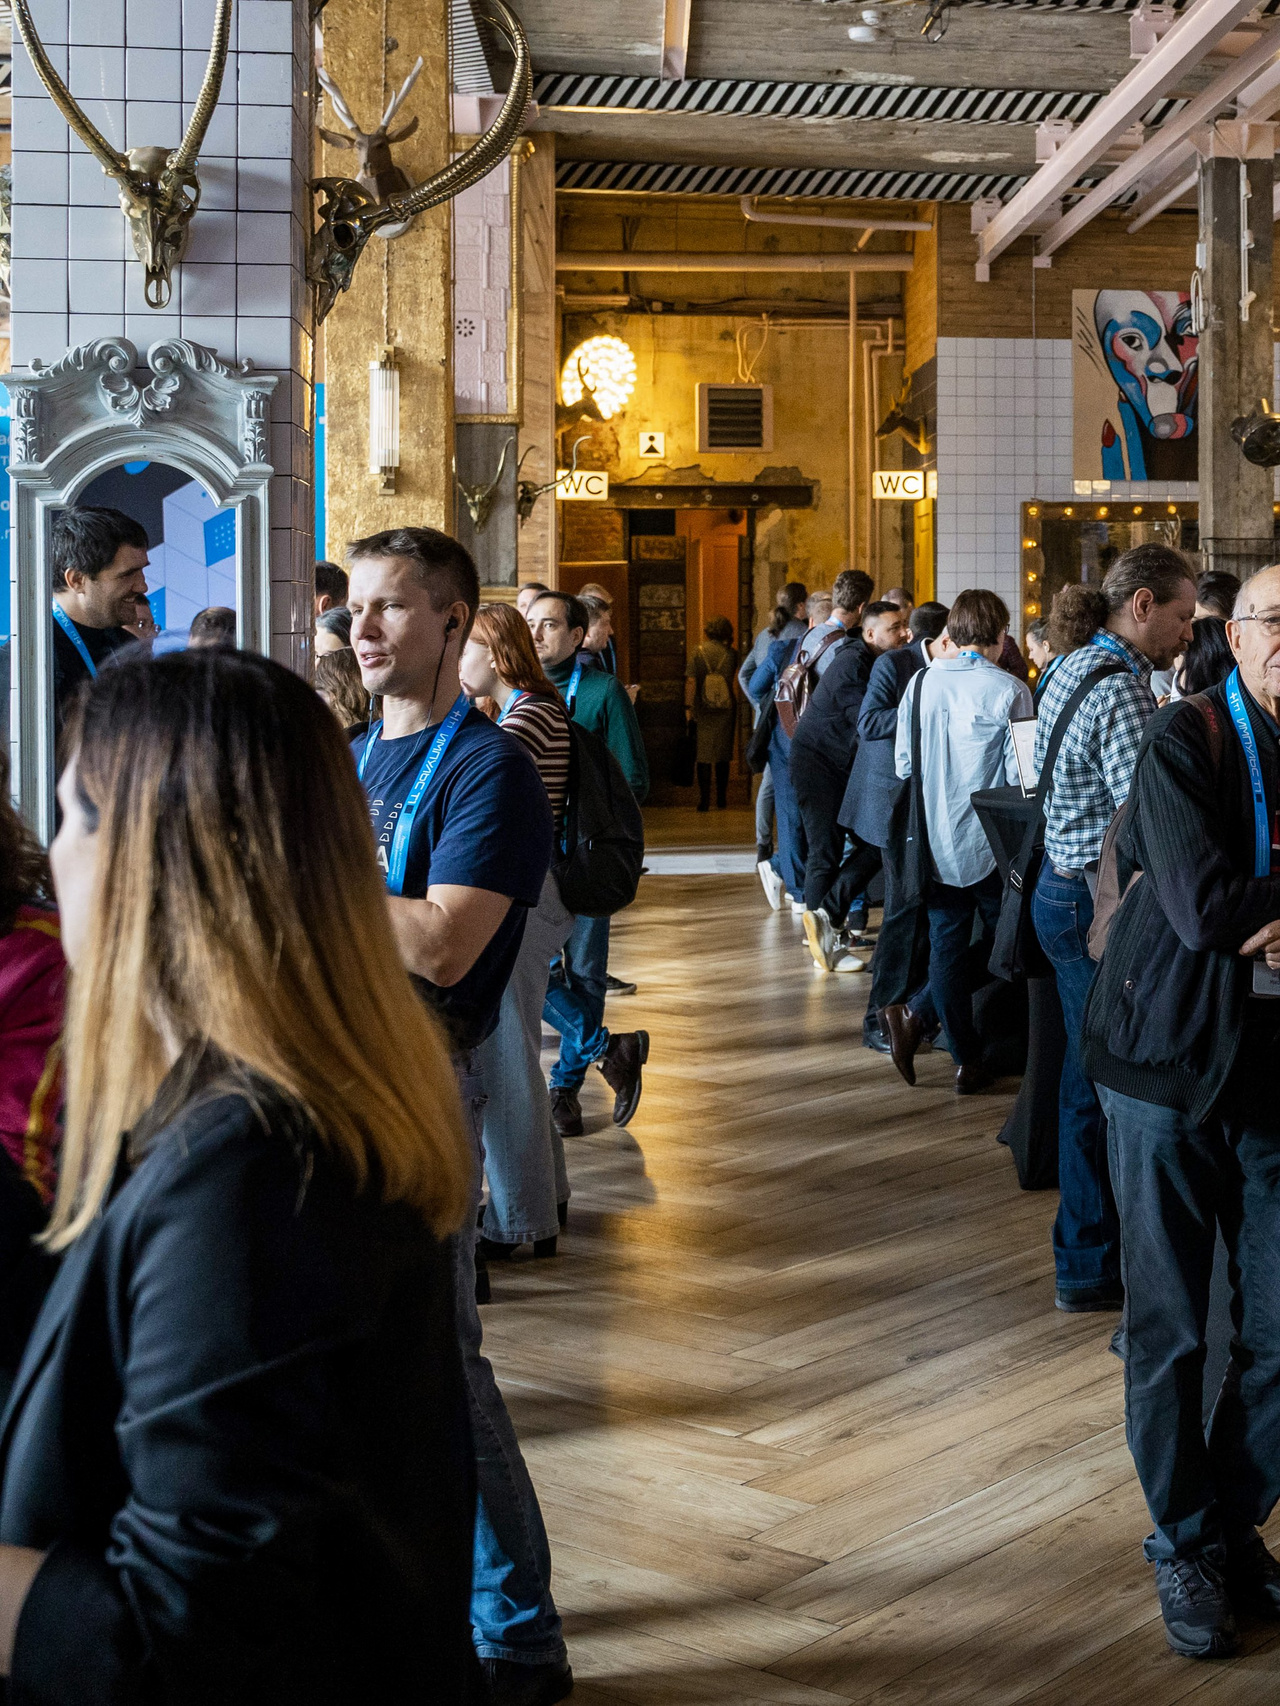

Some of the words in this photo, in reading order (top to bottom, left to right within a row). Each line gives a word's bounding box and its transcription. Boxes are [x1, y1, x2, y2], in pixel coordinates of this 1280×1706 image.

[561, 475, 604, 495] WC
[879, 475, 919, 494] WC
[414, 732, 449, 790] ИМПУЛЬС
[1237, 717, 1260, 777] ИМПУЛЬС
[1253, 780, 1262, 793] Т1
[407, 792, 420, 805] Т1
